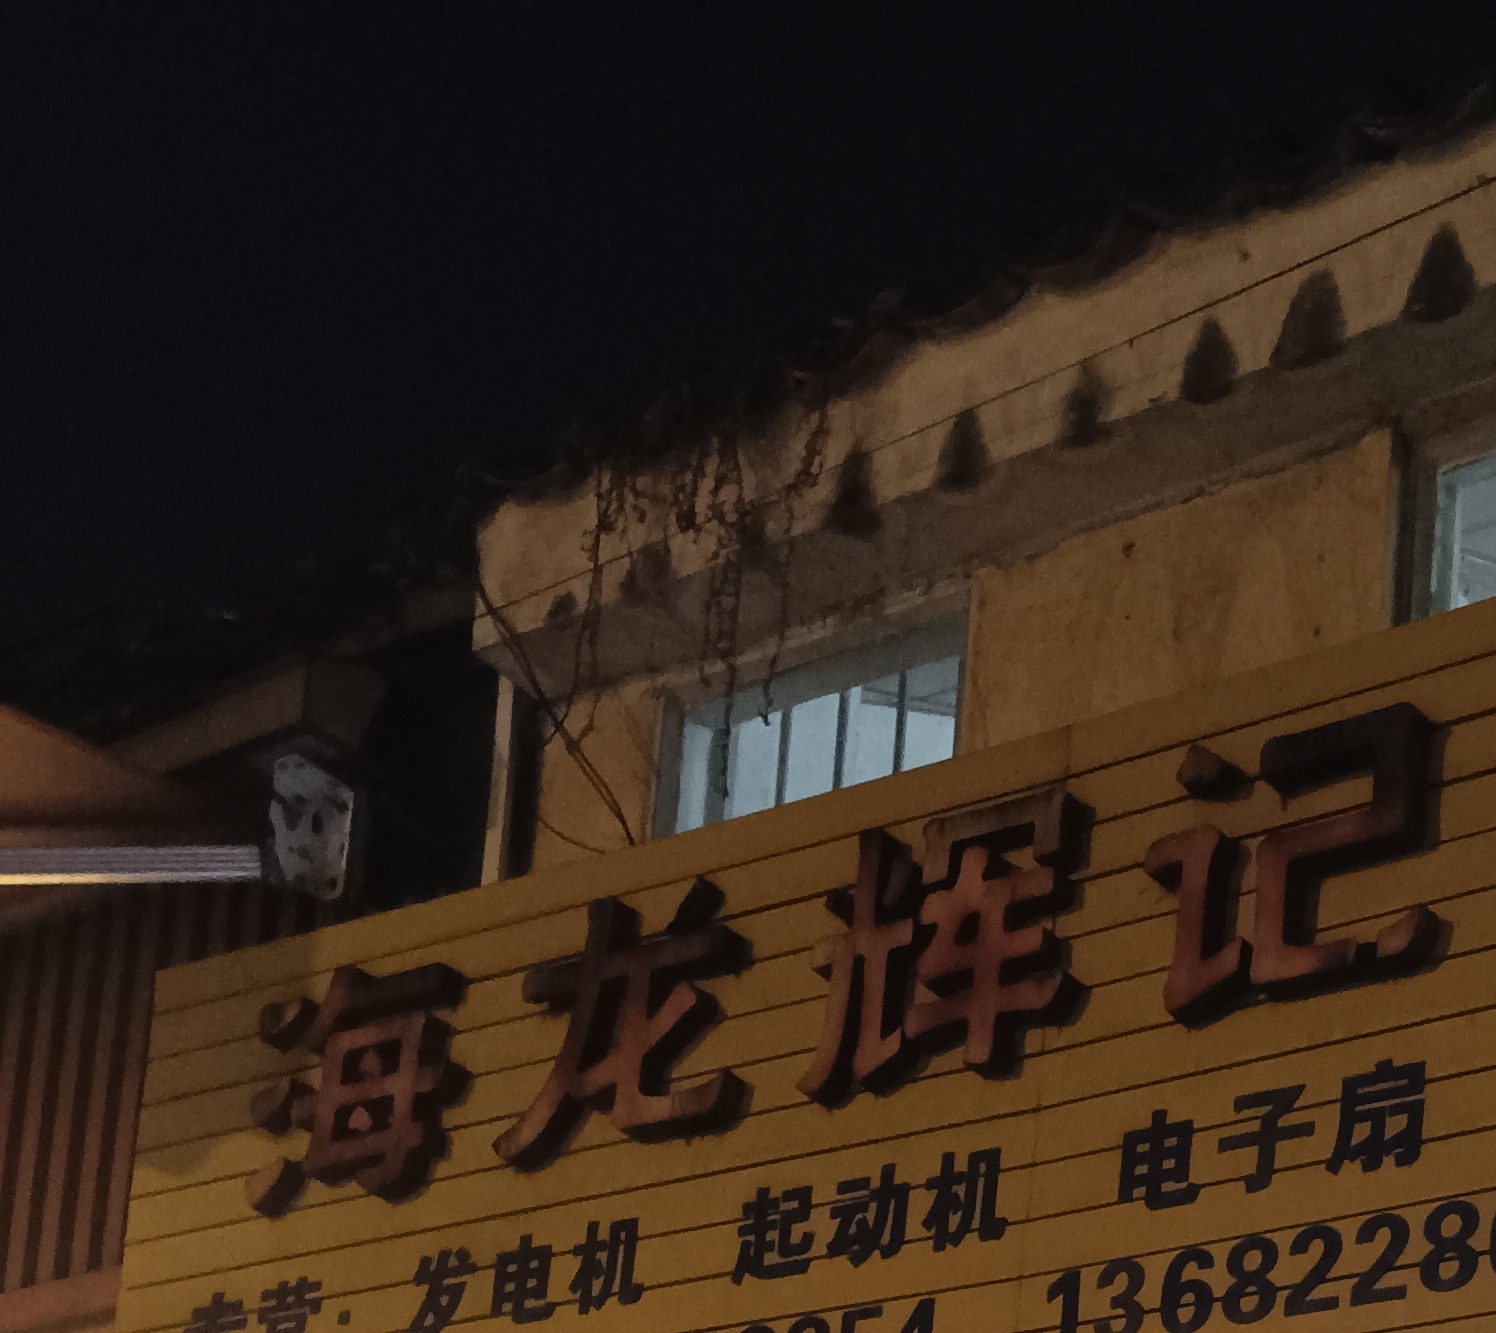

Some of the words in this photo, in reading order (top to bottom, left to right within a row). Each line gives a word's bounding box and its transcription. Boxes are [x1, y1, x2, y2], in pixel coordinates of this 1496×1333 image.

[731, 1148, 1007, 1285] 起动机
[1116, 1060, 1428, 1211] 电子扇
